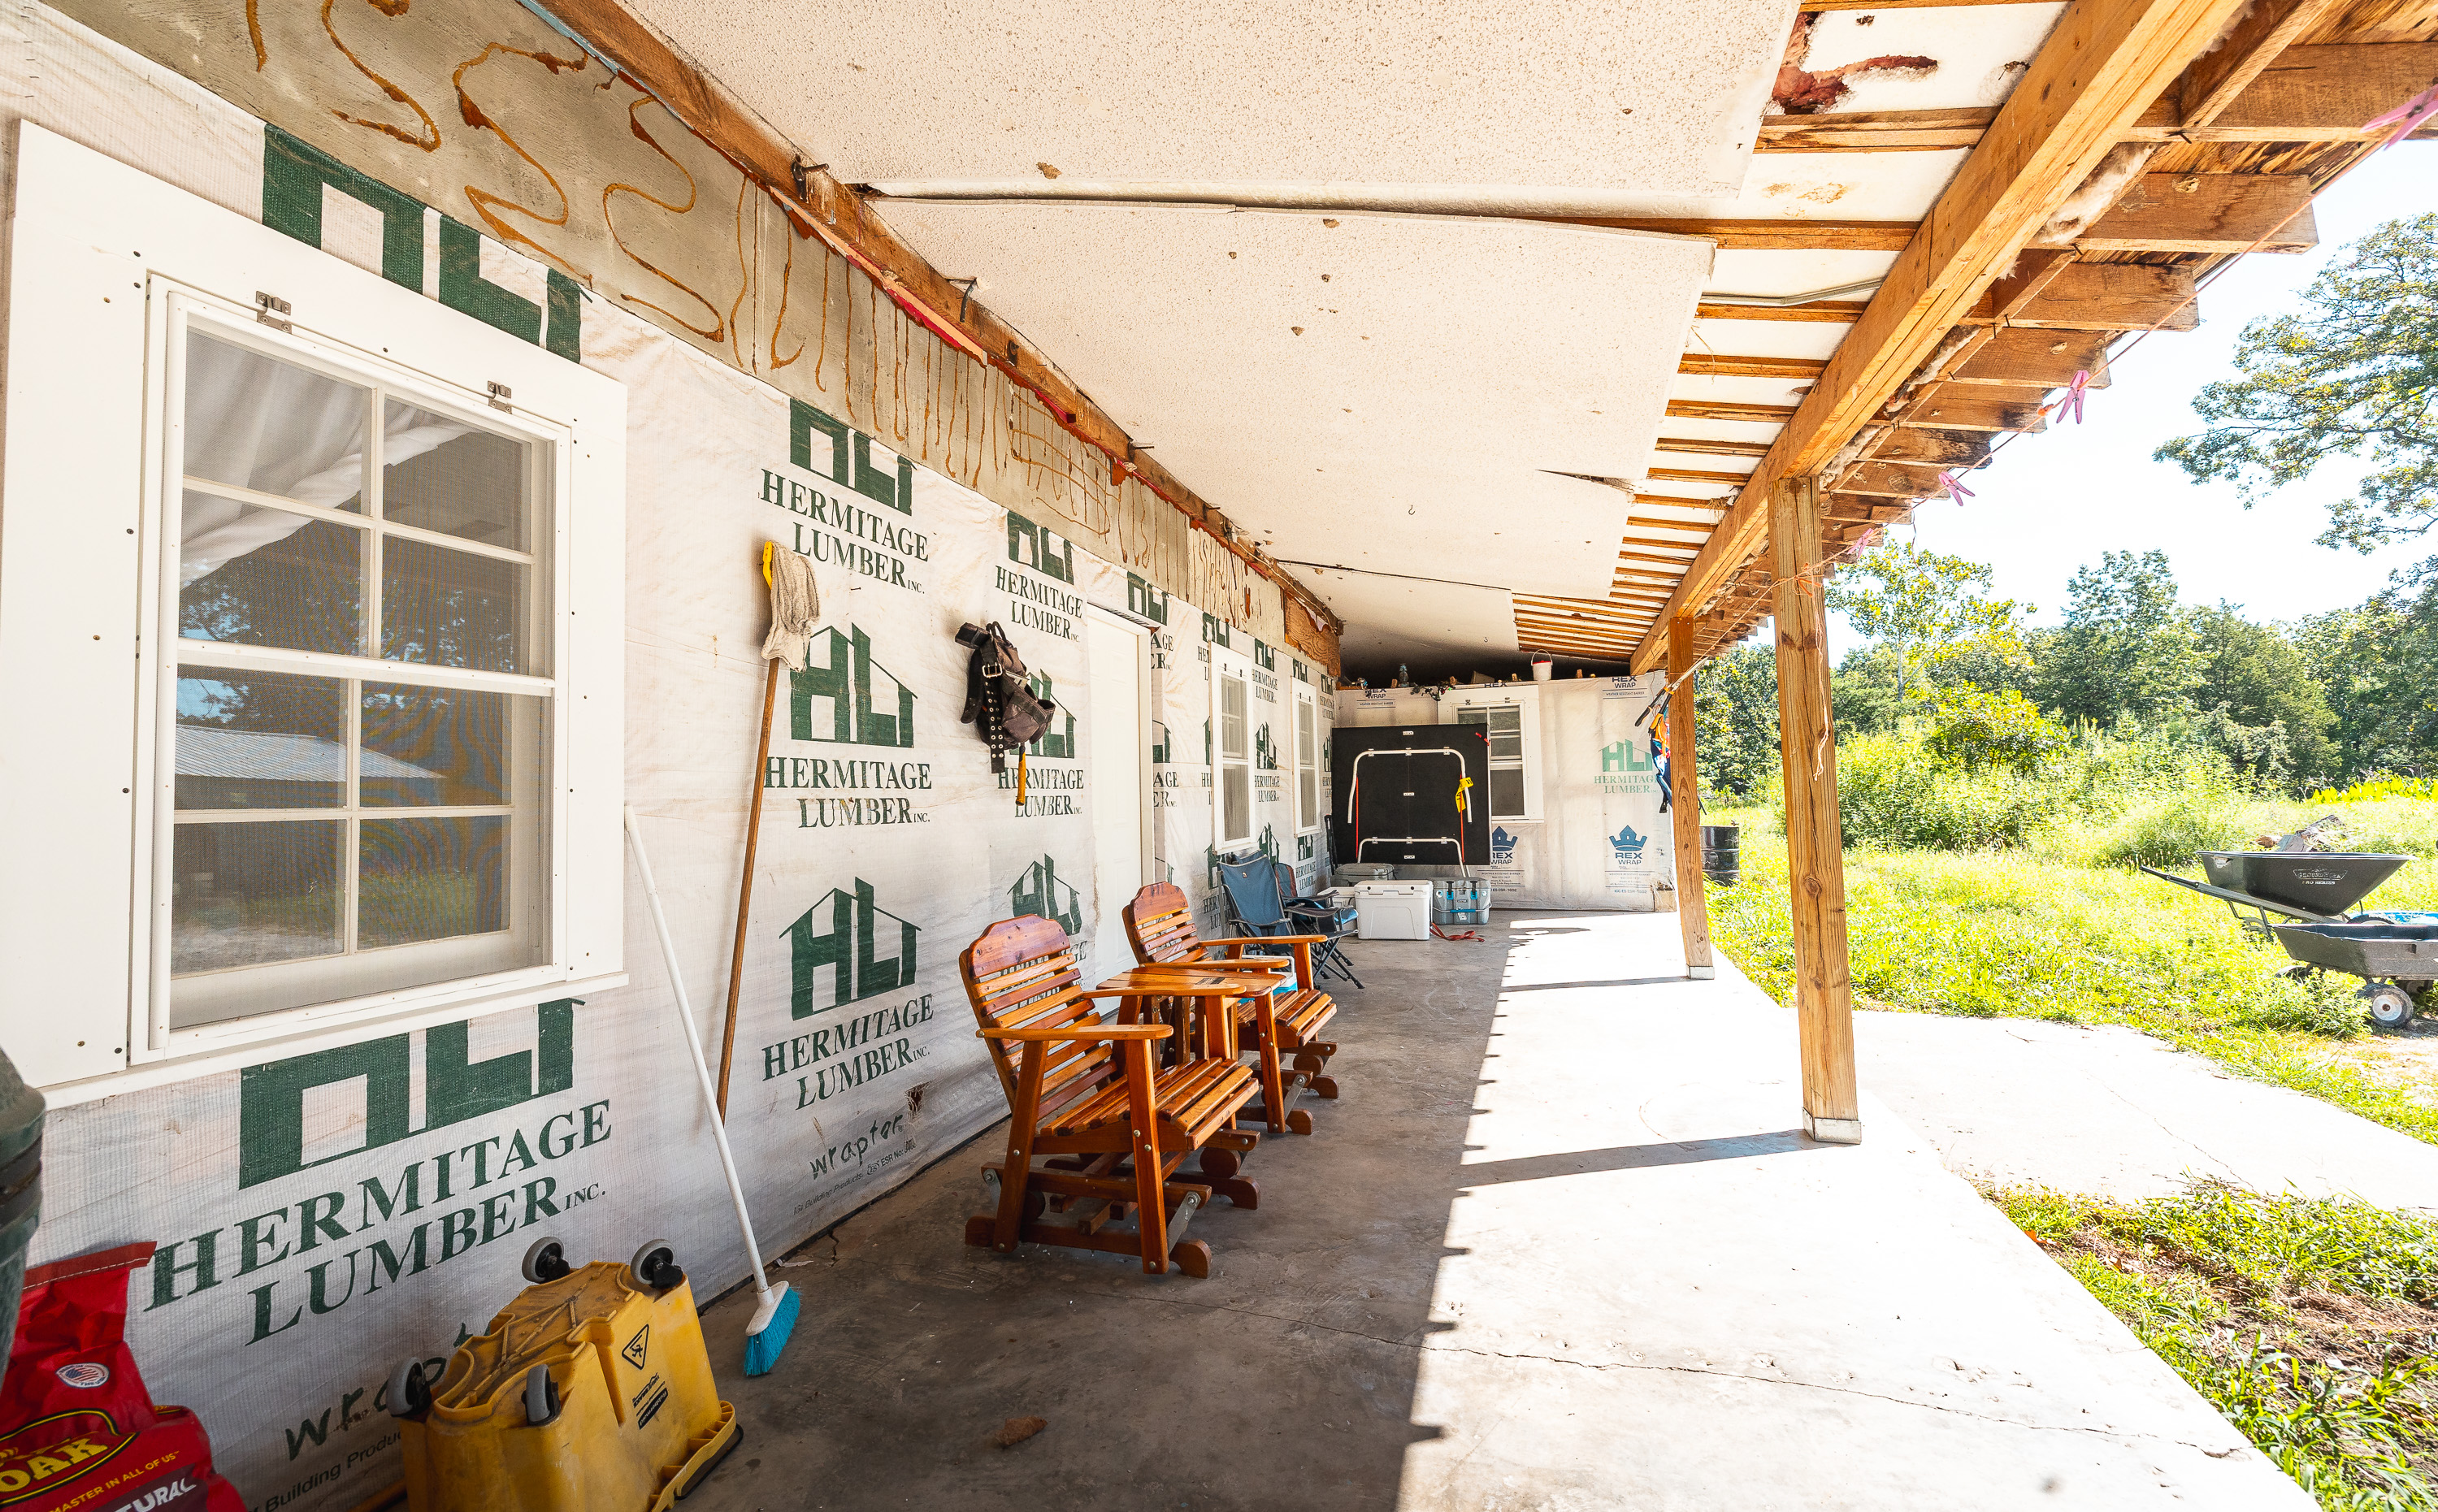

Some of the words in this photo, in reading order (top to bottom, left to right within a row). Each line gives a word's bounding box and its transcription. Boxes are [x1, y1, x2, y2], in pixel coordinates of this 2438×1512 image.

[761, 468, 929, 561] HERMITAGE
[792, 522, 906, 588] LUMBER
[908, 579, 925, 594] INC.
[996, 565, 1083, 618] HERMITAGE
[1011, 600, 1071, 640] LUMBER
[764, 756, 933, 790] HERMITAGE
[1255, 775, 1279, 787] HERMITAGE
[1258, 791, 1277, 802] LUMBER
[796, 797, 912, 829] LUMBER
[913, 812, 931, 823] INC.
[761, 993, 934, 1081] HERMITAGE
[795, 1038, 913, 1110] LUMBER
[912, 1046, 930, 1062] INC.
[144, 1099, 612, 1311] HERMITAGE
[805, 1190, 832, 1211] Building
[881, 1154, 894, 1167] ESR
[245, 1176, 565, 1346] LUMBER
[563, 1183, 605, 1211] INC.
[0, 1437, 109, 1493] OAK
[105, 1477, 120, 1489] IN
[123, 1467, 145, 1482] ALL
[145, 1459, 161, 1471] OF
[265, 1463, 341, 1512] Building
[346, 1432, 401, 1469] Produ
